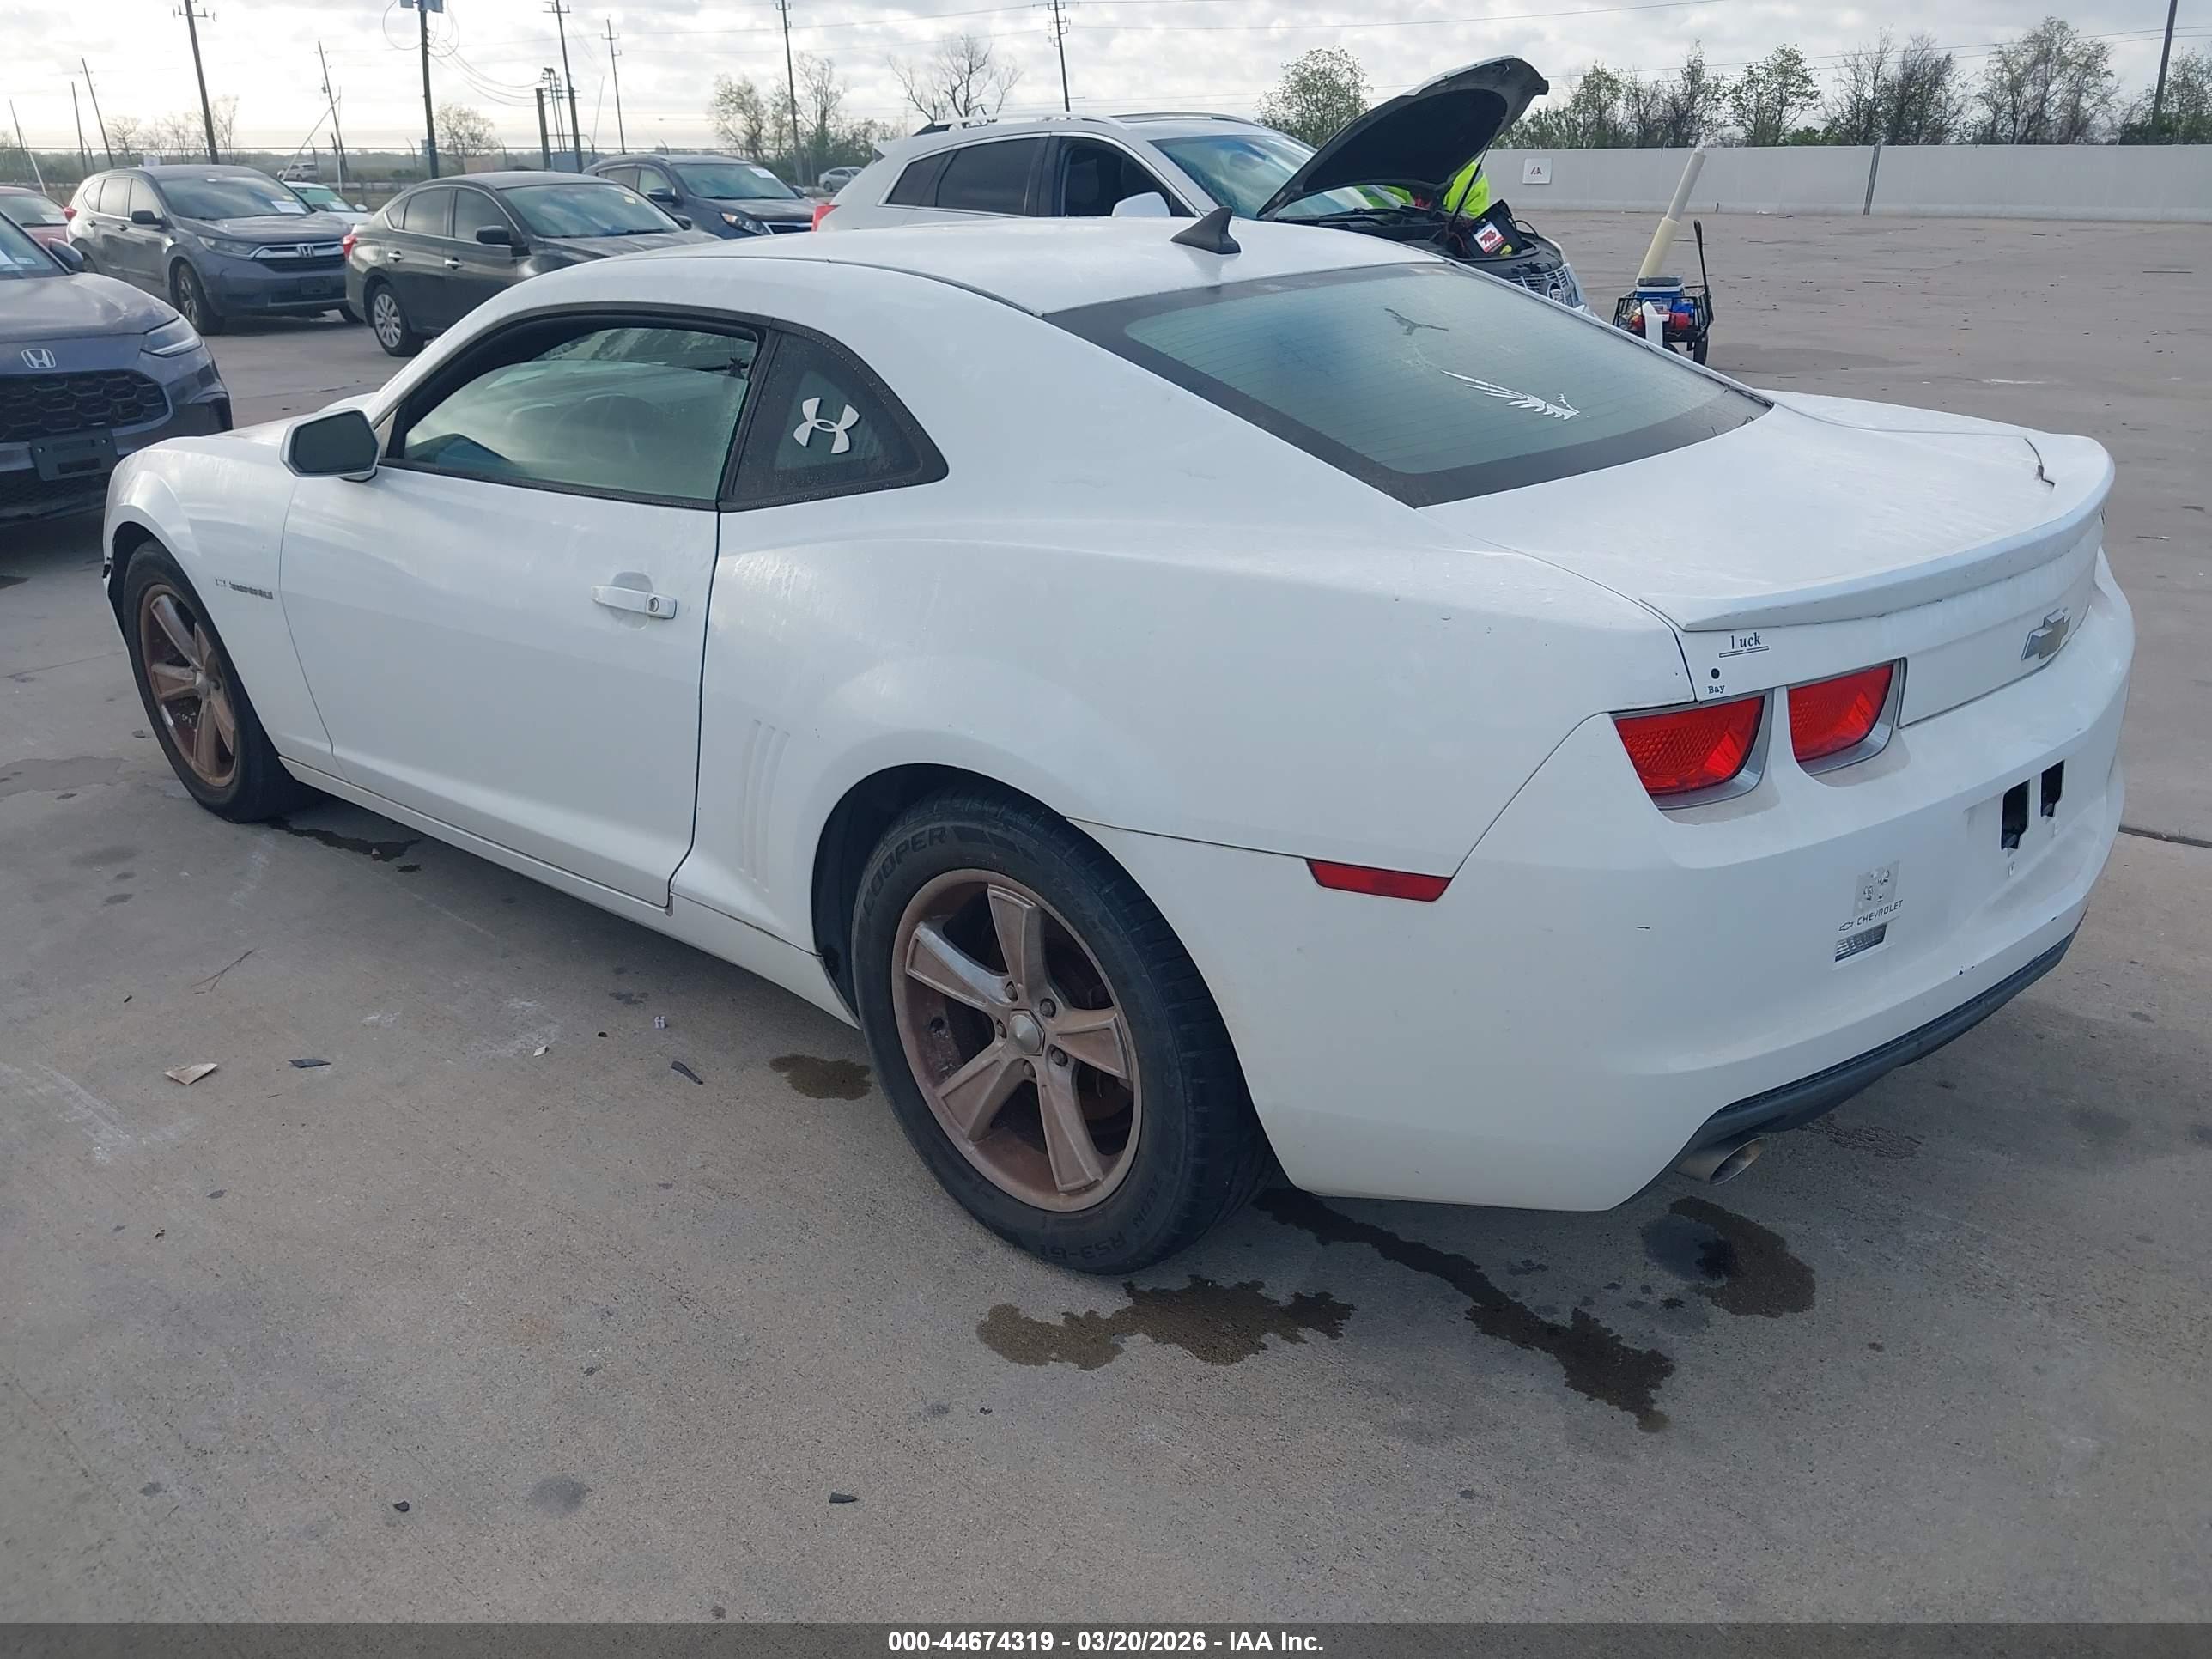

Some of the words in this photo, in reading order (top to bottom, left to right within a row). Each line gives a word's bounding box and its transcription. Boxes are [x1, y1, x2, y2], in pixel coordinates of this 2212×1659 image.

[1707, 684, 1725, 694] Bay
[862, 825, 947, 916] COOPER
[1856, 899, 1904, 926] CHEVROLET
